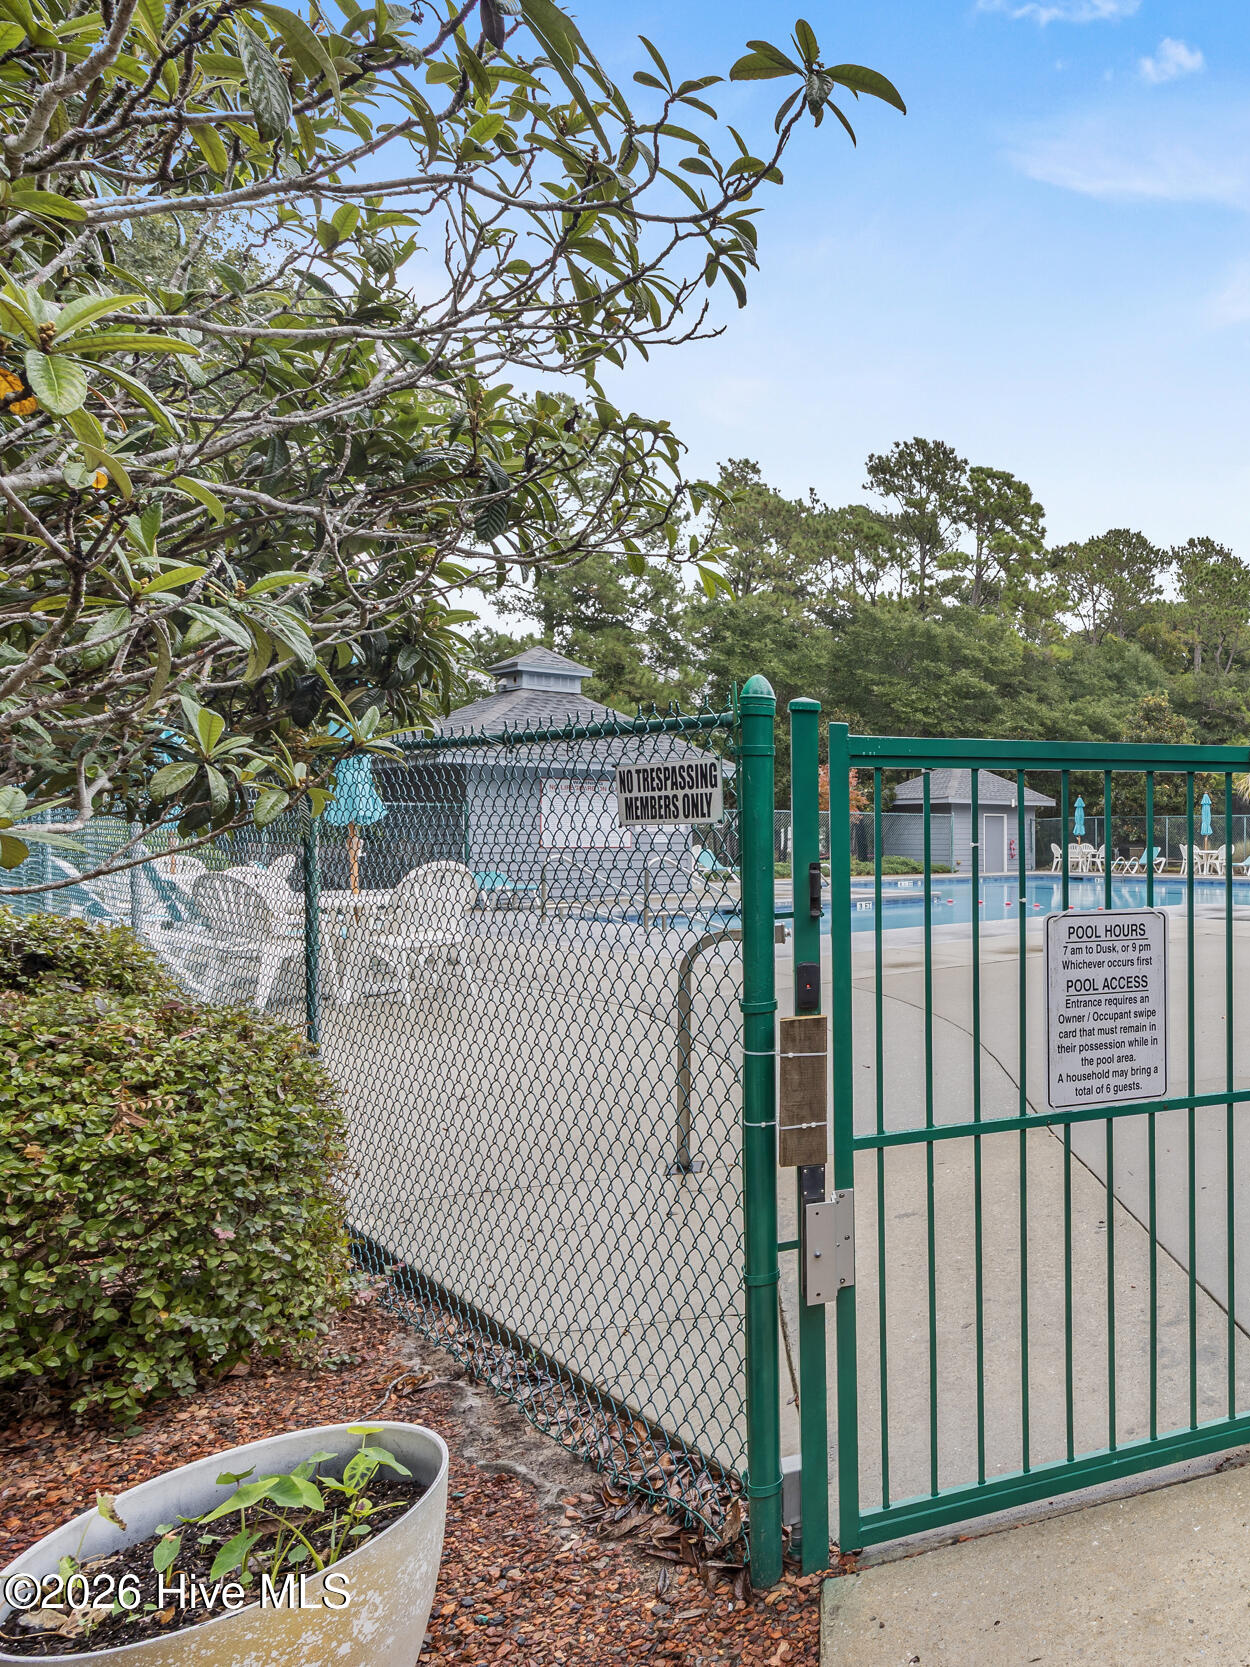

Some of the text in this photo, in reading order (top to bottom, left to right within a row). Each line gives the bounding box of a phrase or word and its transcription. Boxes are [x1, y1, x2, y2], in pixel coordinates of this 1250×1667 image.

[618, 762, 718, 793] NO TRESPASSING
[625, 792, 712, 820] MEMBERS ONLY
[1068, 923, 1146, 940] POOL HOURS
[1063, 943, 1151, 955] 7 am to Dusk, or 9 pm
[1062, 956, 1152, 970] Whichever occurs first
[1066, 975, 1148, 992] POOL ACCESS
[1066, 996, 1149, 1008] Entrance requires an
[1058, 1009, 1156, 1024] Owner / Occupant swipe
[1059, 1023, 1156, 1039] card that must remain in
[1057, 1036, 1158, 1054] their possession while in
[1081, 1053, 1136, 1067] the pool area.
[1058, 1065, 1158, 1083] A household may bring a
[1075, 1082, 1142, 1096] total of 6 guests.
